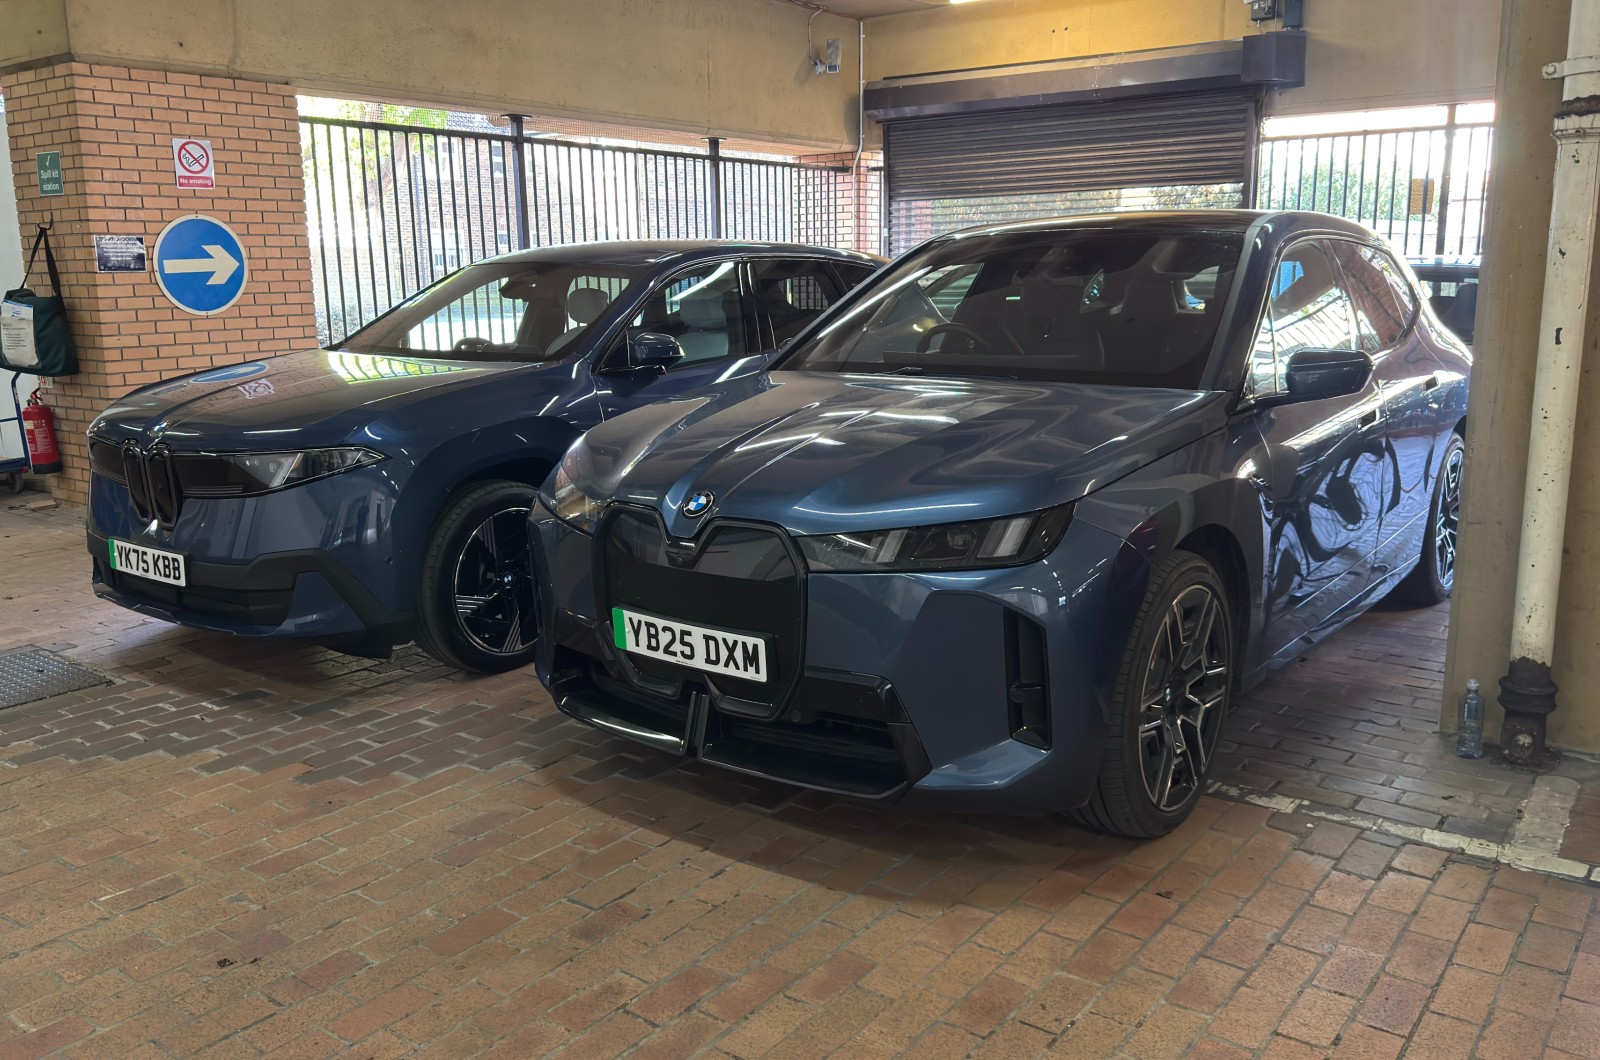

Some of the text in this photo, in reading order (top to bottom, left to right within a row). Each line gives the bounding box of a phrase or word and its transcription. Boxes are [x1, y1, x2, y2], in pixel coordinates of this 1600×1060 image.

[41, 169, 51, 180] Spill
[43, 182, 60, 191] station
[189, 178, 212, 186] smoking
[116, 544, 181, 581] YK75 KBB
[628, 616, 760, 675] YB25 DXM
